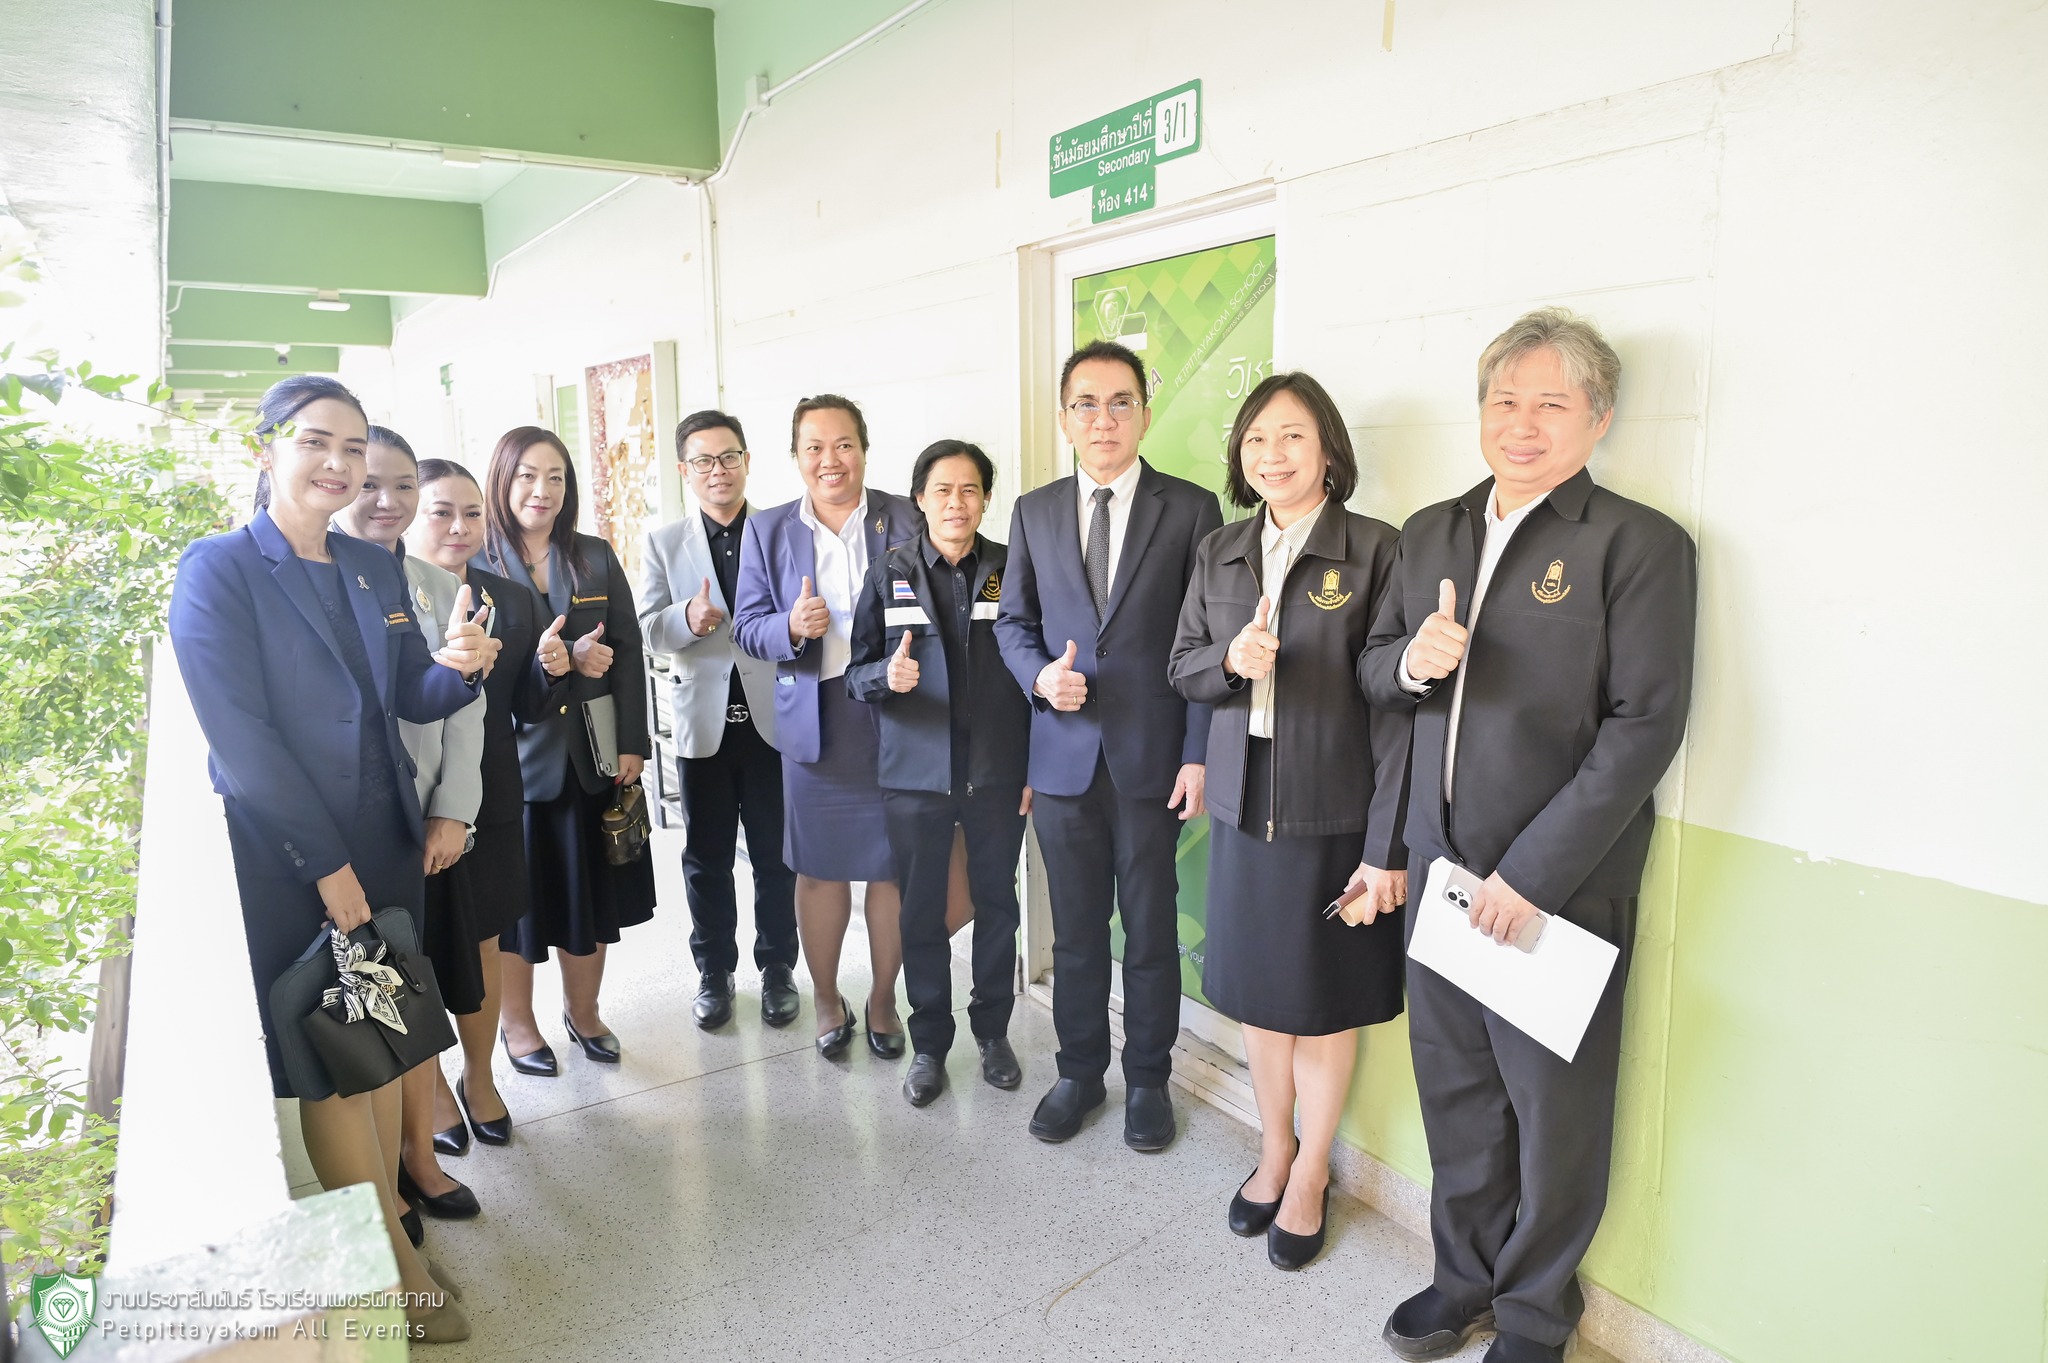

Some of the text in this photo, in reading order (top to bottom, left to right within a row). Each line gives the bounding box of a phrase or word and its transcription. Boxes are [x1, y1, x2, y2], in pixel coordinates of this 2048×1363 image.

[1053, 100, 1186, 169] ชั้นมัธยมศึกษาปีที่ 3/1
[1098, 148, 1151, 176] Secondary
[1098, 183, 1148, 214] ห้อง 414
[1245, 273, 1275, 309] School
